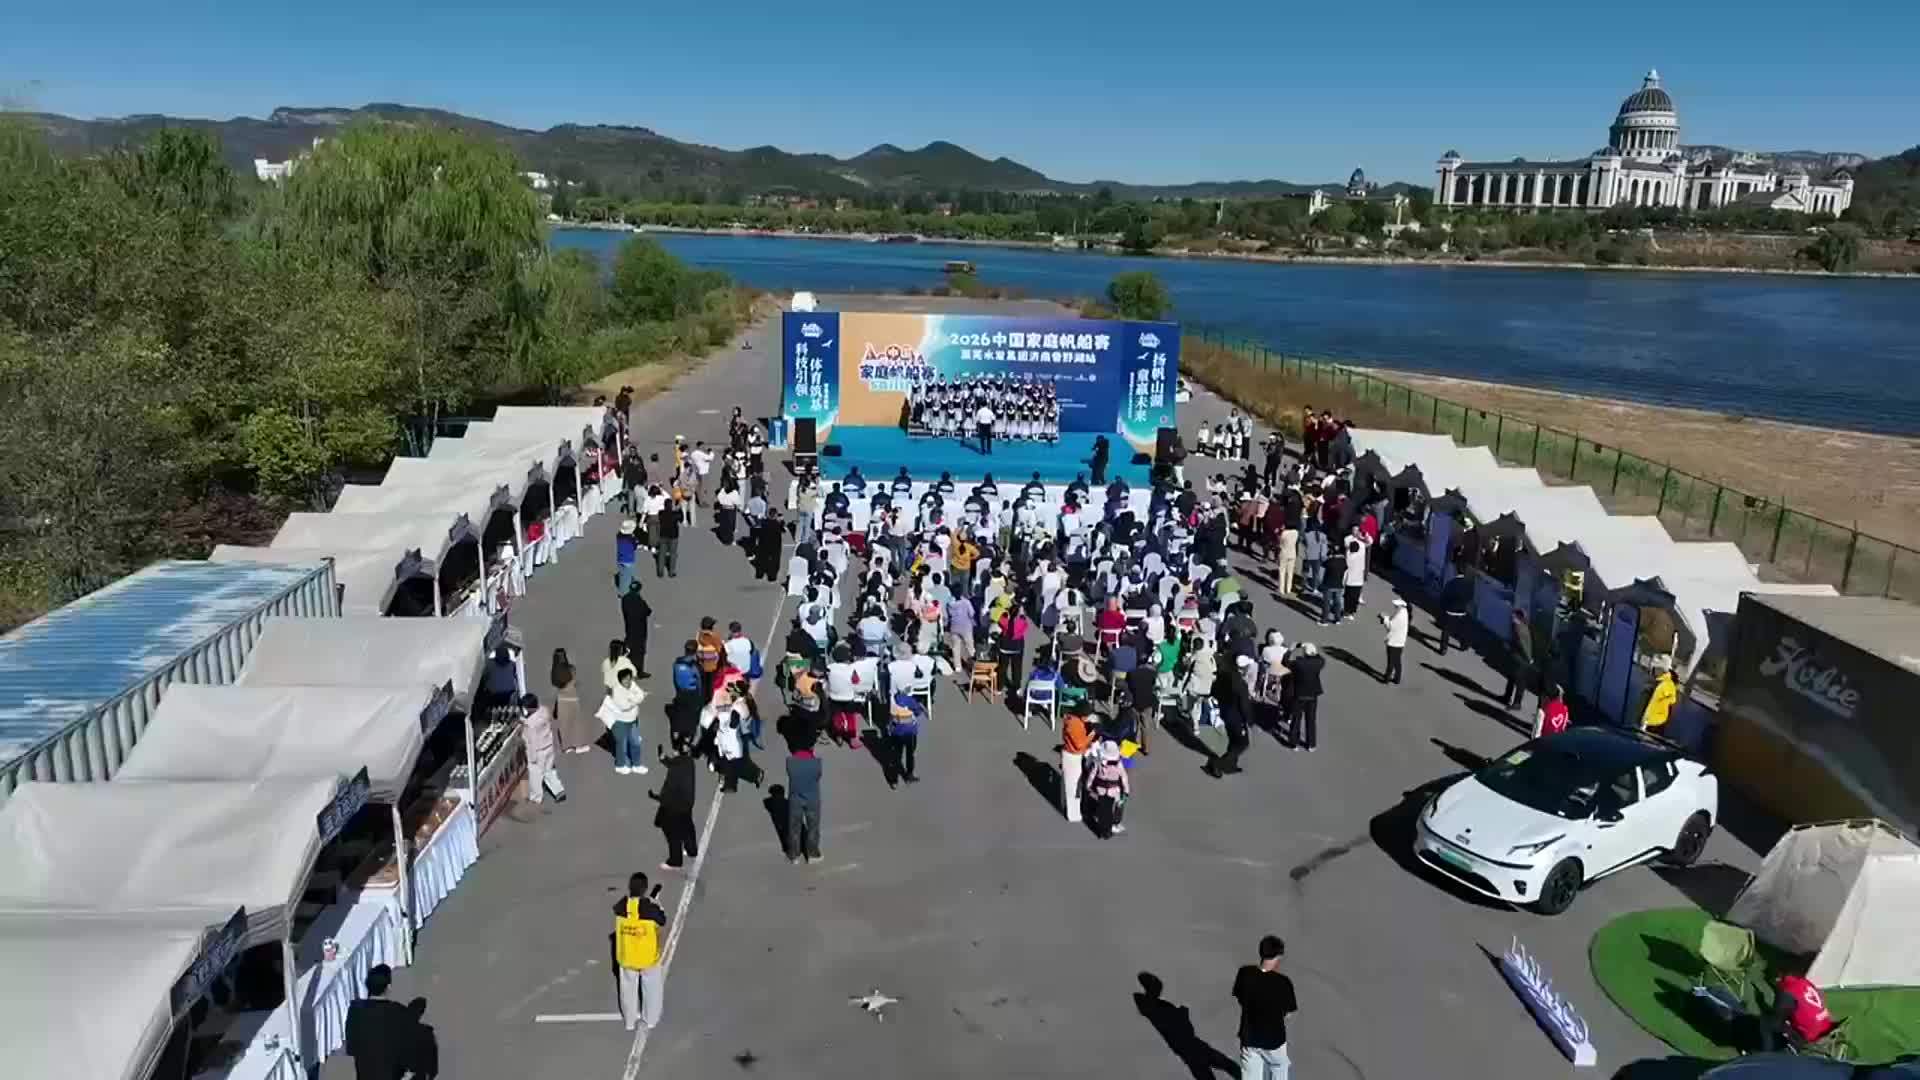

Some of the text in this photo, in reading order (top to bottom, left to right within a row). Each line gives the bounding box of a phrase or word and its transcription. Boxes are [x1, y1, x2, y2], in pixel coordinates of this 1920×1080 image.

[950, 332, 1110, 350] 2026中国家庭帆船赛
[795, 342, 808, 396] 科技引领
[1151, 353, 1166, 408] 扬帆山湖
